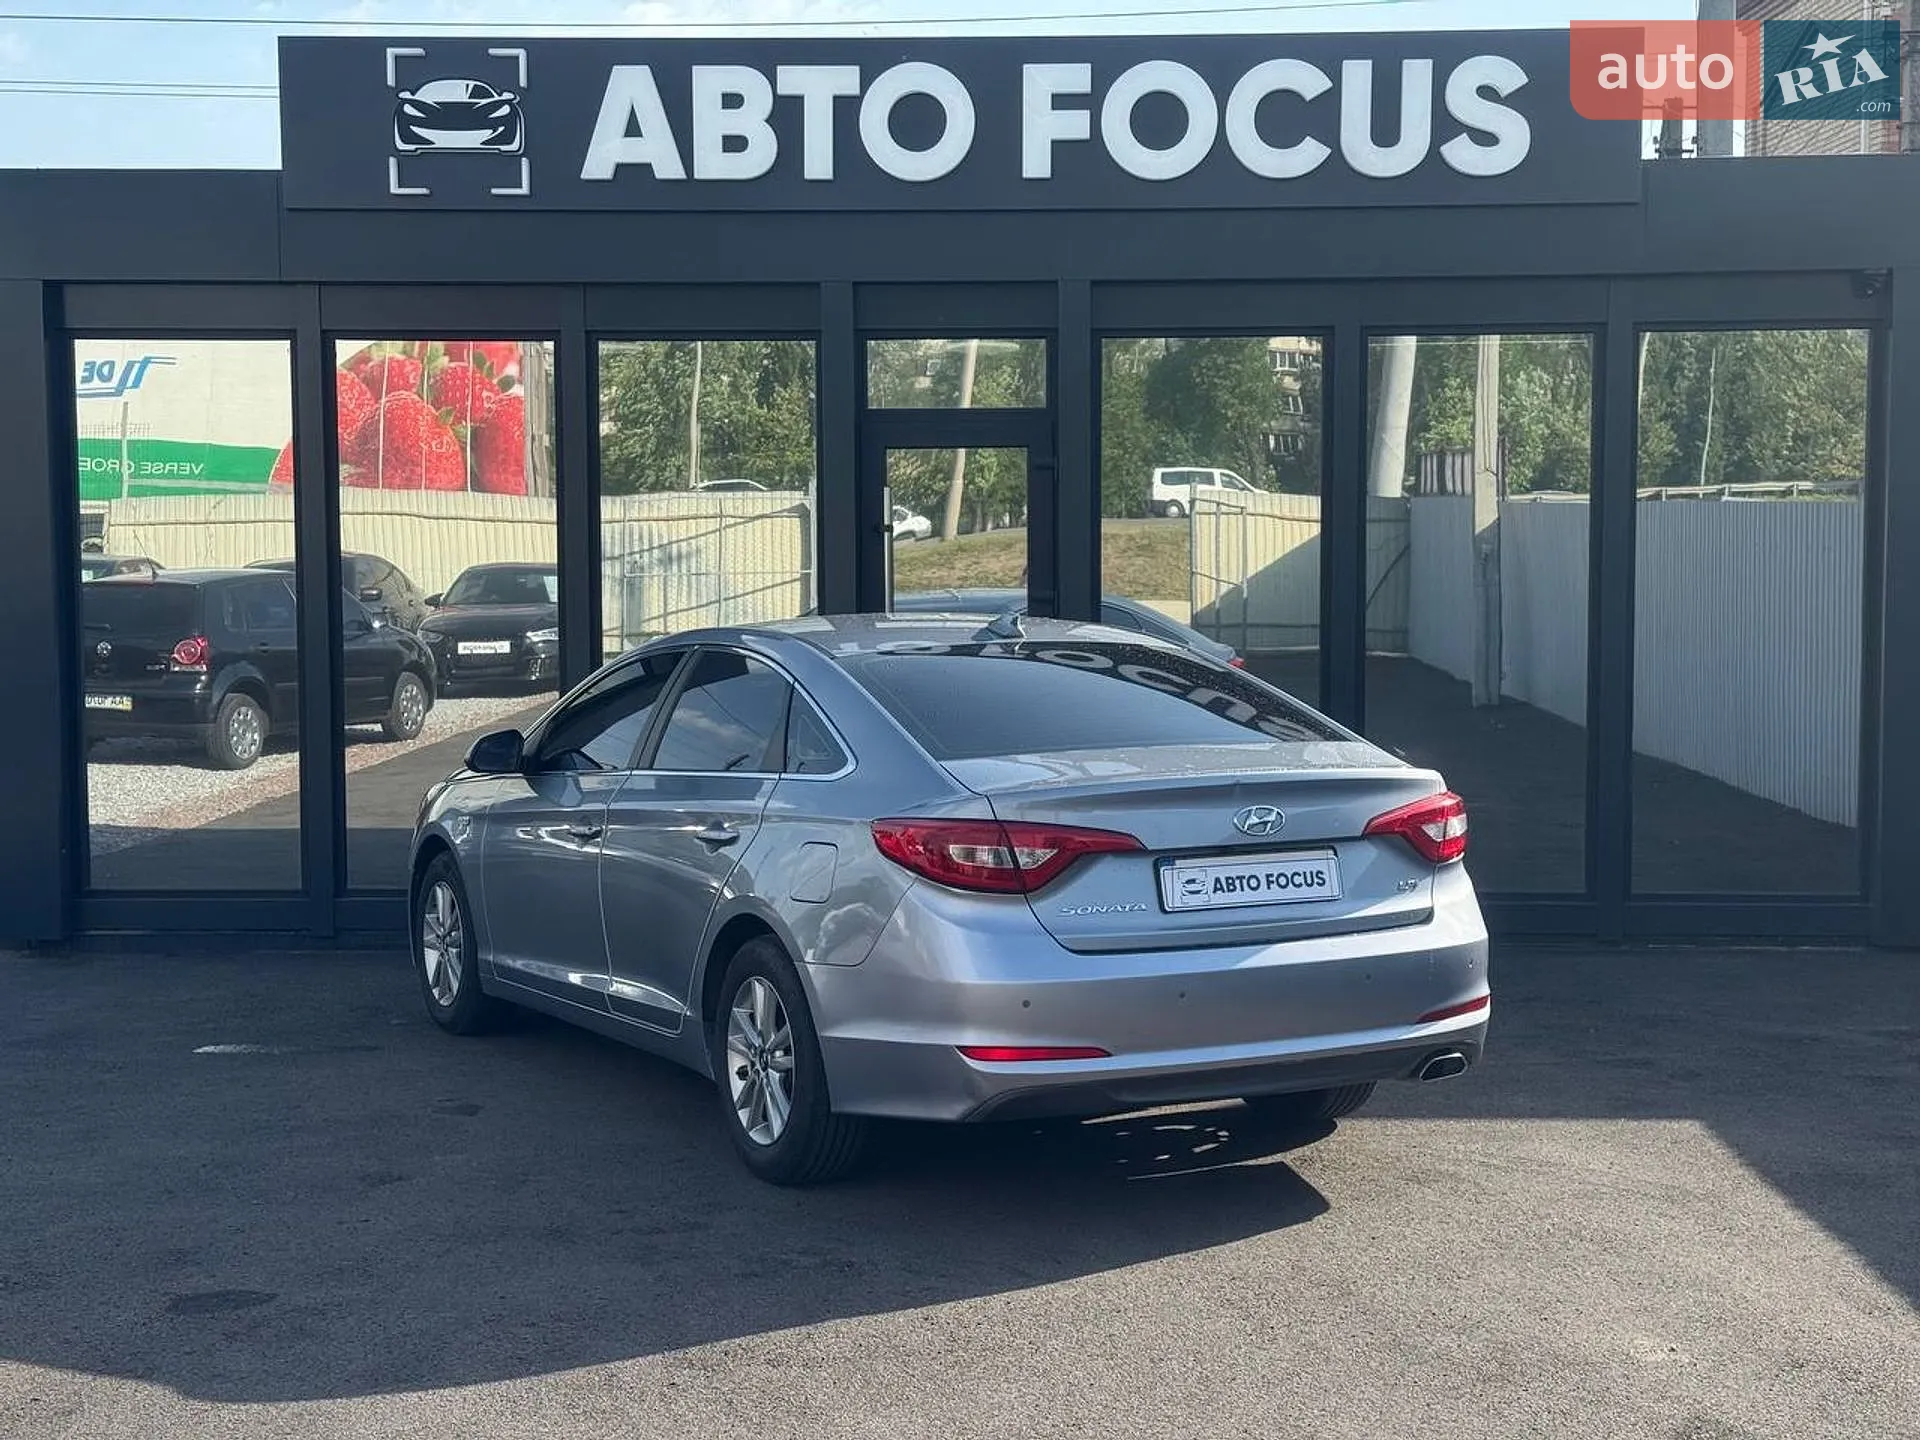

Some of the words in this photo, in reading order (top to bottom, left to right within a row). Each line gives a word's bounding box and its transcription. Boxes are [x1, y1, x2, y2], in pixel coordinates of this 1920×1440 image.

[1021, 55, 1531, 181] FOCUS
[1266, 870, 1326, 890] FOCUS
[1059, 902, 1148, 917] SONATA
